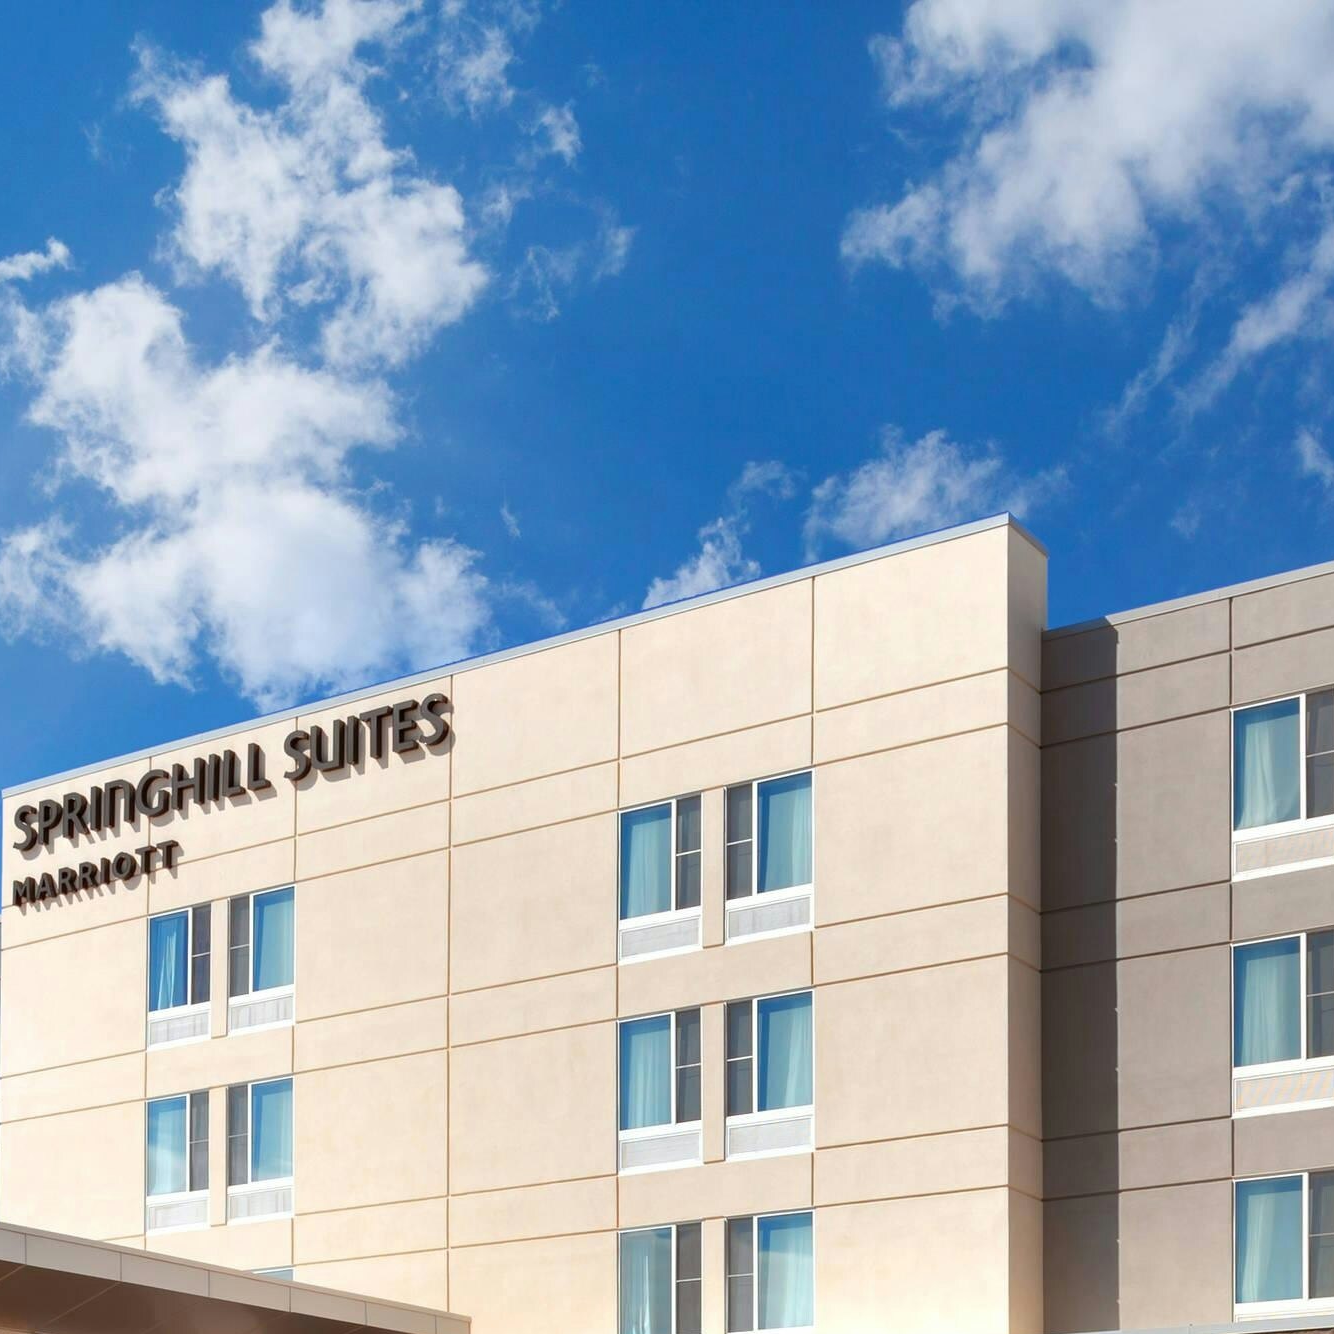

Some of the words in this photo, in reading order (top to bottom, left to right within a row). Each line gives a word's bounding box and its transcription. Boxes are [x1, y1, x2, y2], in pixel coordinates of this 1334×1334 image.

[13, 743, 272, 852] SPRINGHILL
[283, 692, 451, 781] SUITES
[12, 840, 179, 907] MARRIOTT
